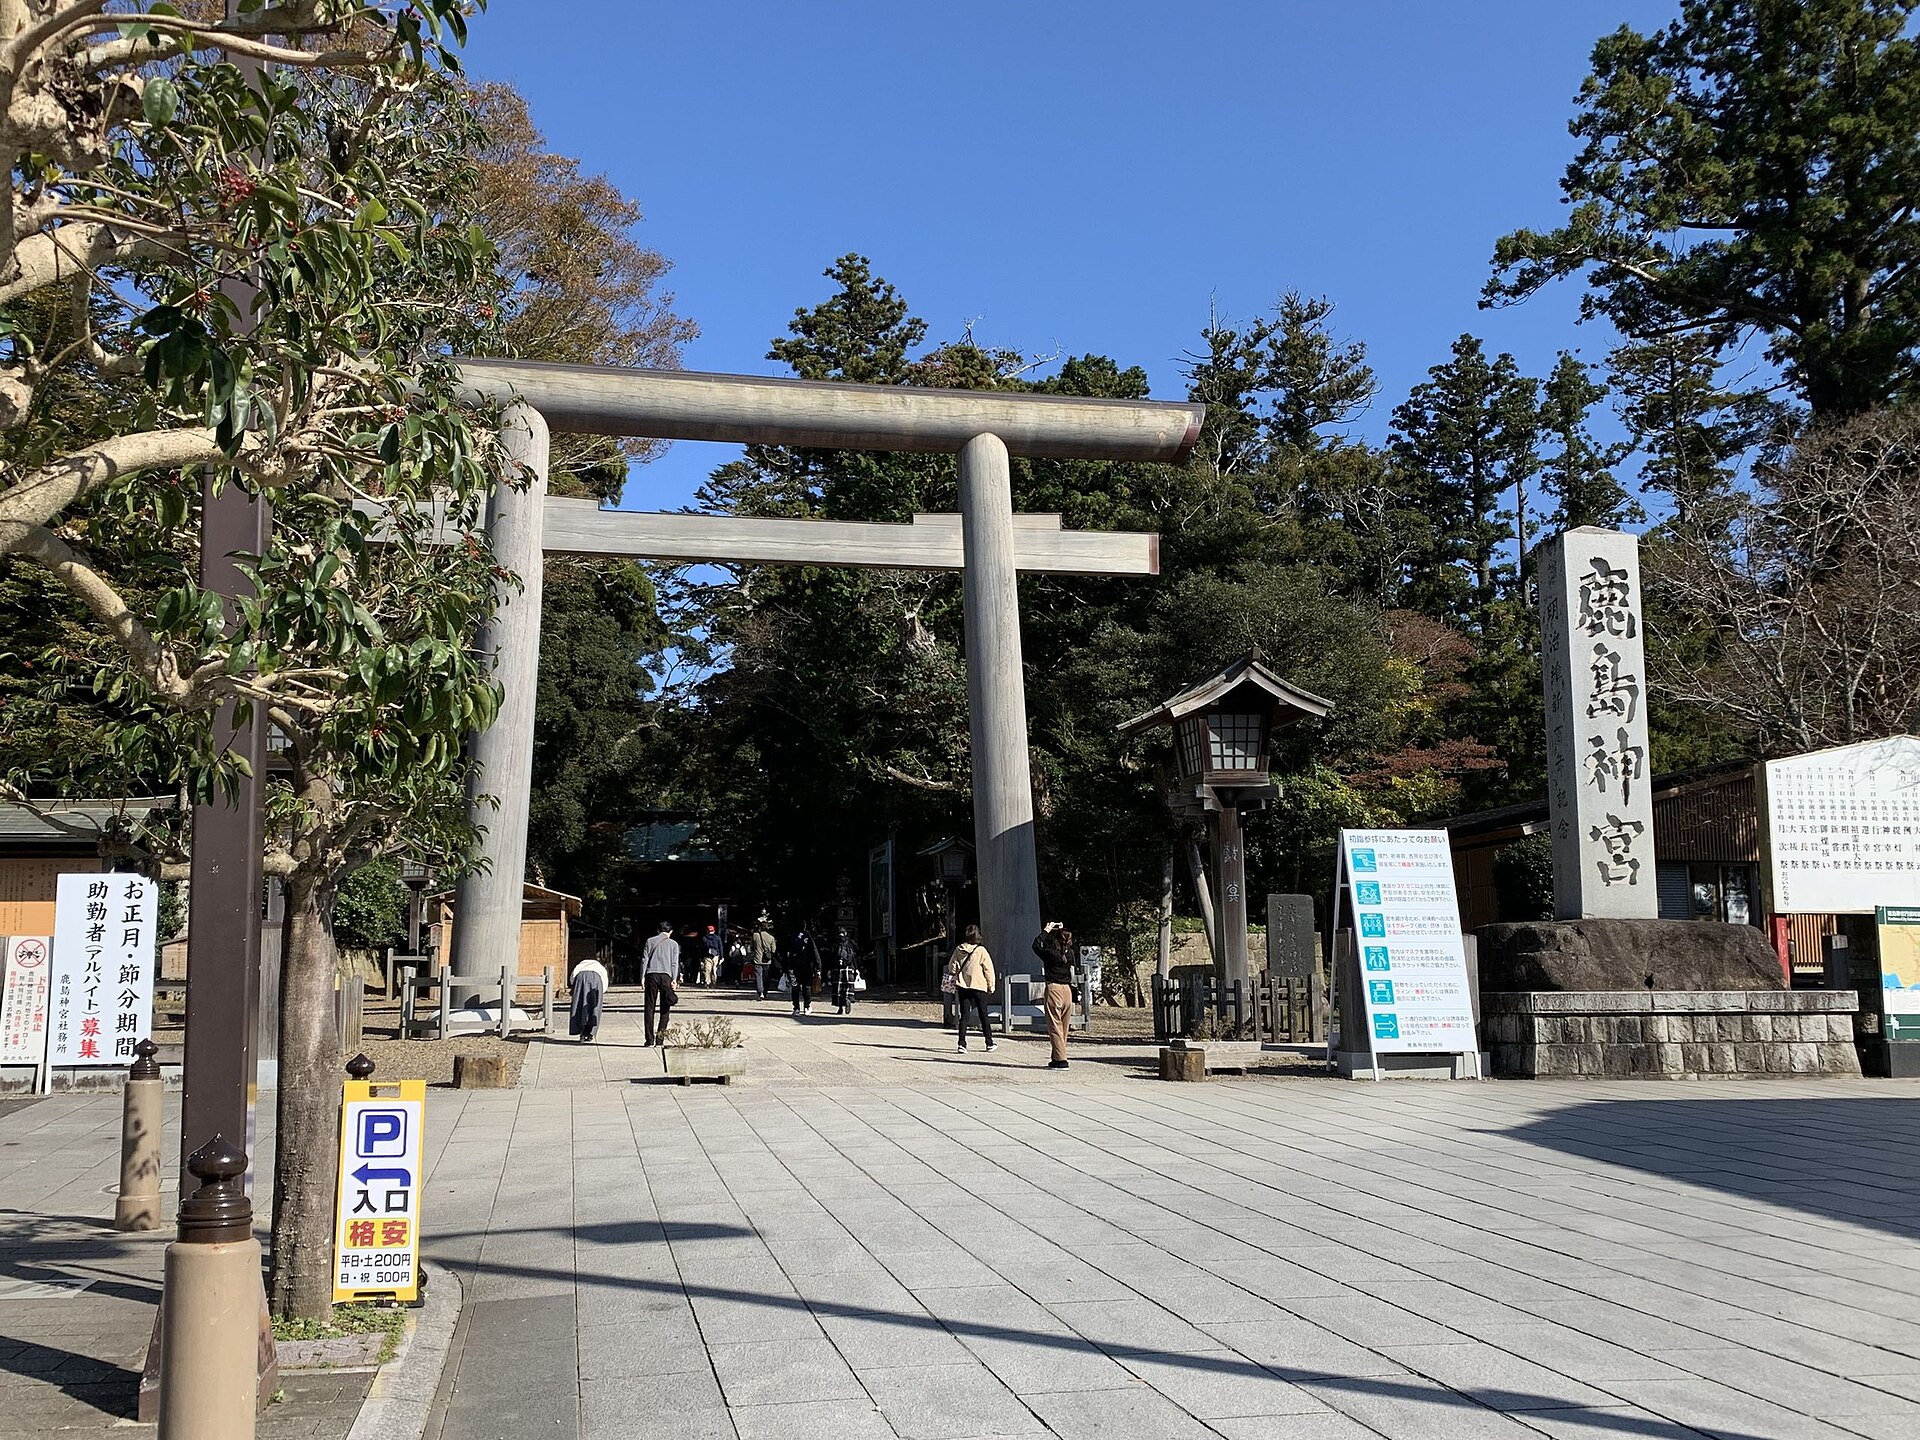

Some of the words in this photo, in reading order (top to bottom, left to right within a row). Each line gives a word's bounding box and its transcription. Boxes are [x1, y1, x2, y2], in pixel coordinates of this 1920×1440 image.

[1575, 555, 1645, 888] 鹿島神宮
[115, 880, 145, 1058] お正月・節分期間
[32, 975, 47, 1033] ドローン禁止
[56, 973, 71, 1055] 鹿島神宮社務所
[363, 1114, 401, 1154] P
[352, 1189, 408, 1214] 入口
[349, 1220, 407, 1247] 格安
[341, 1271, 370, 1284] 日・祝
[376, 1271, 410, 1284] 500円
